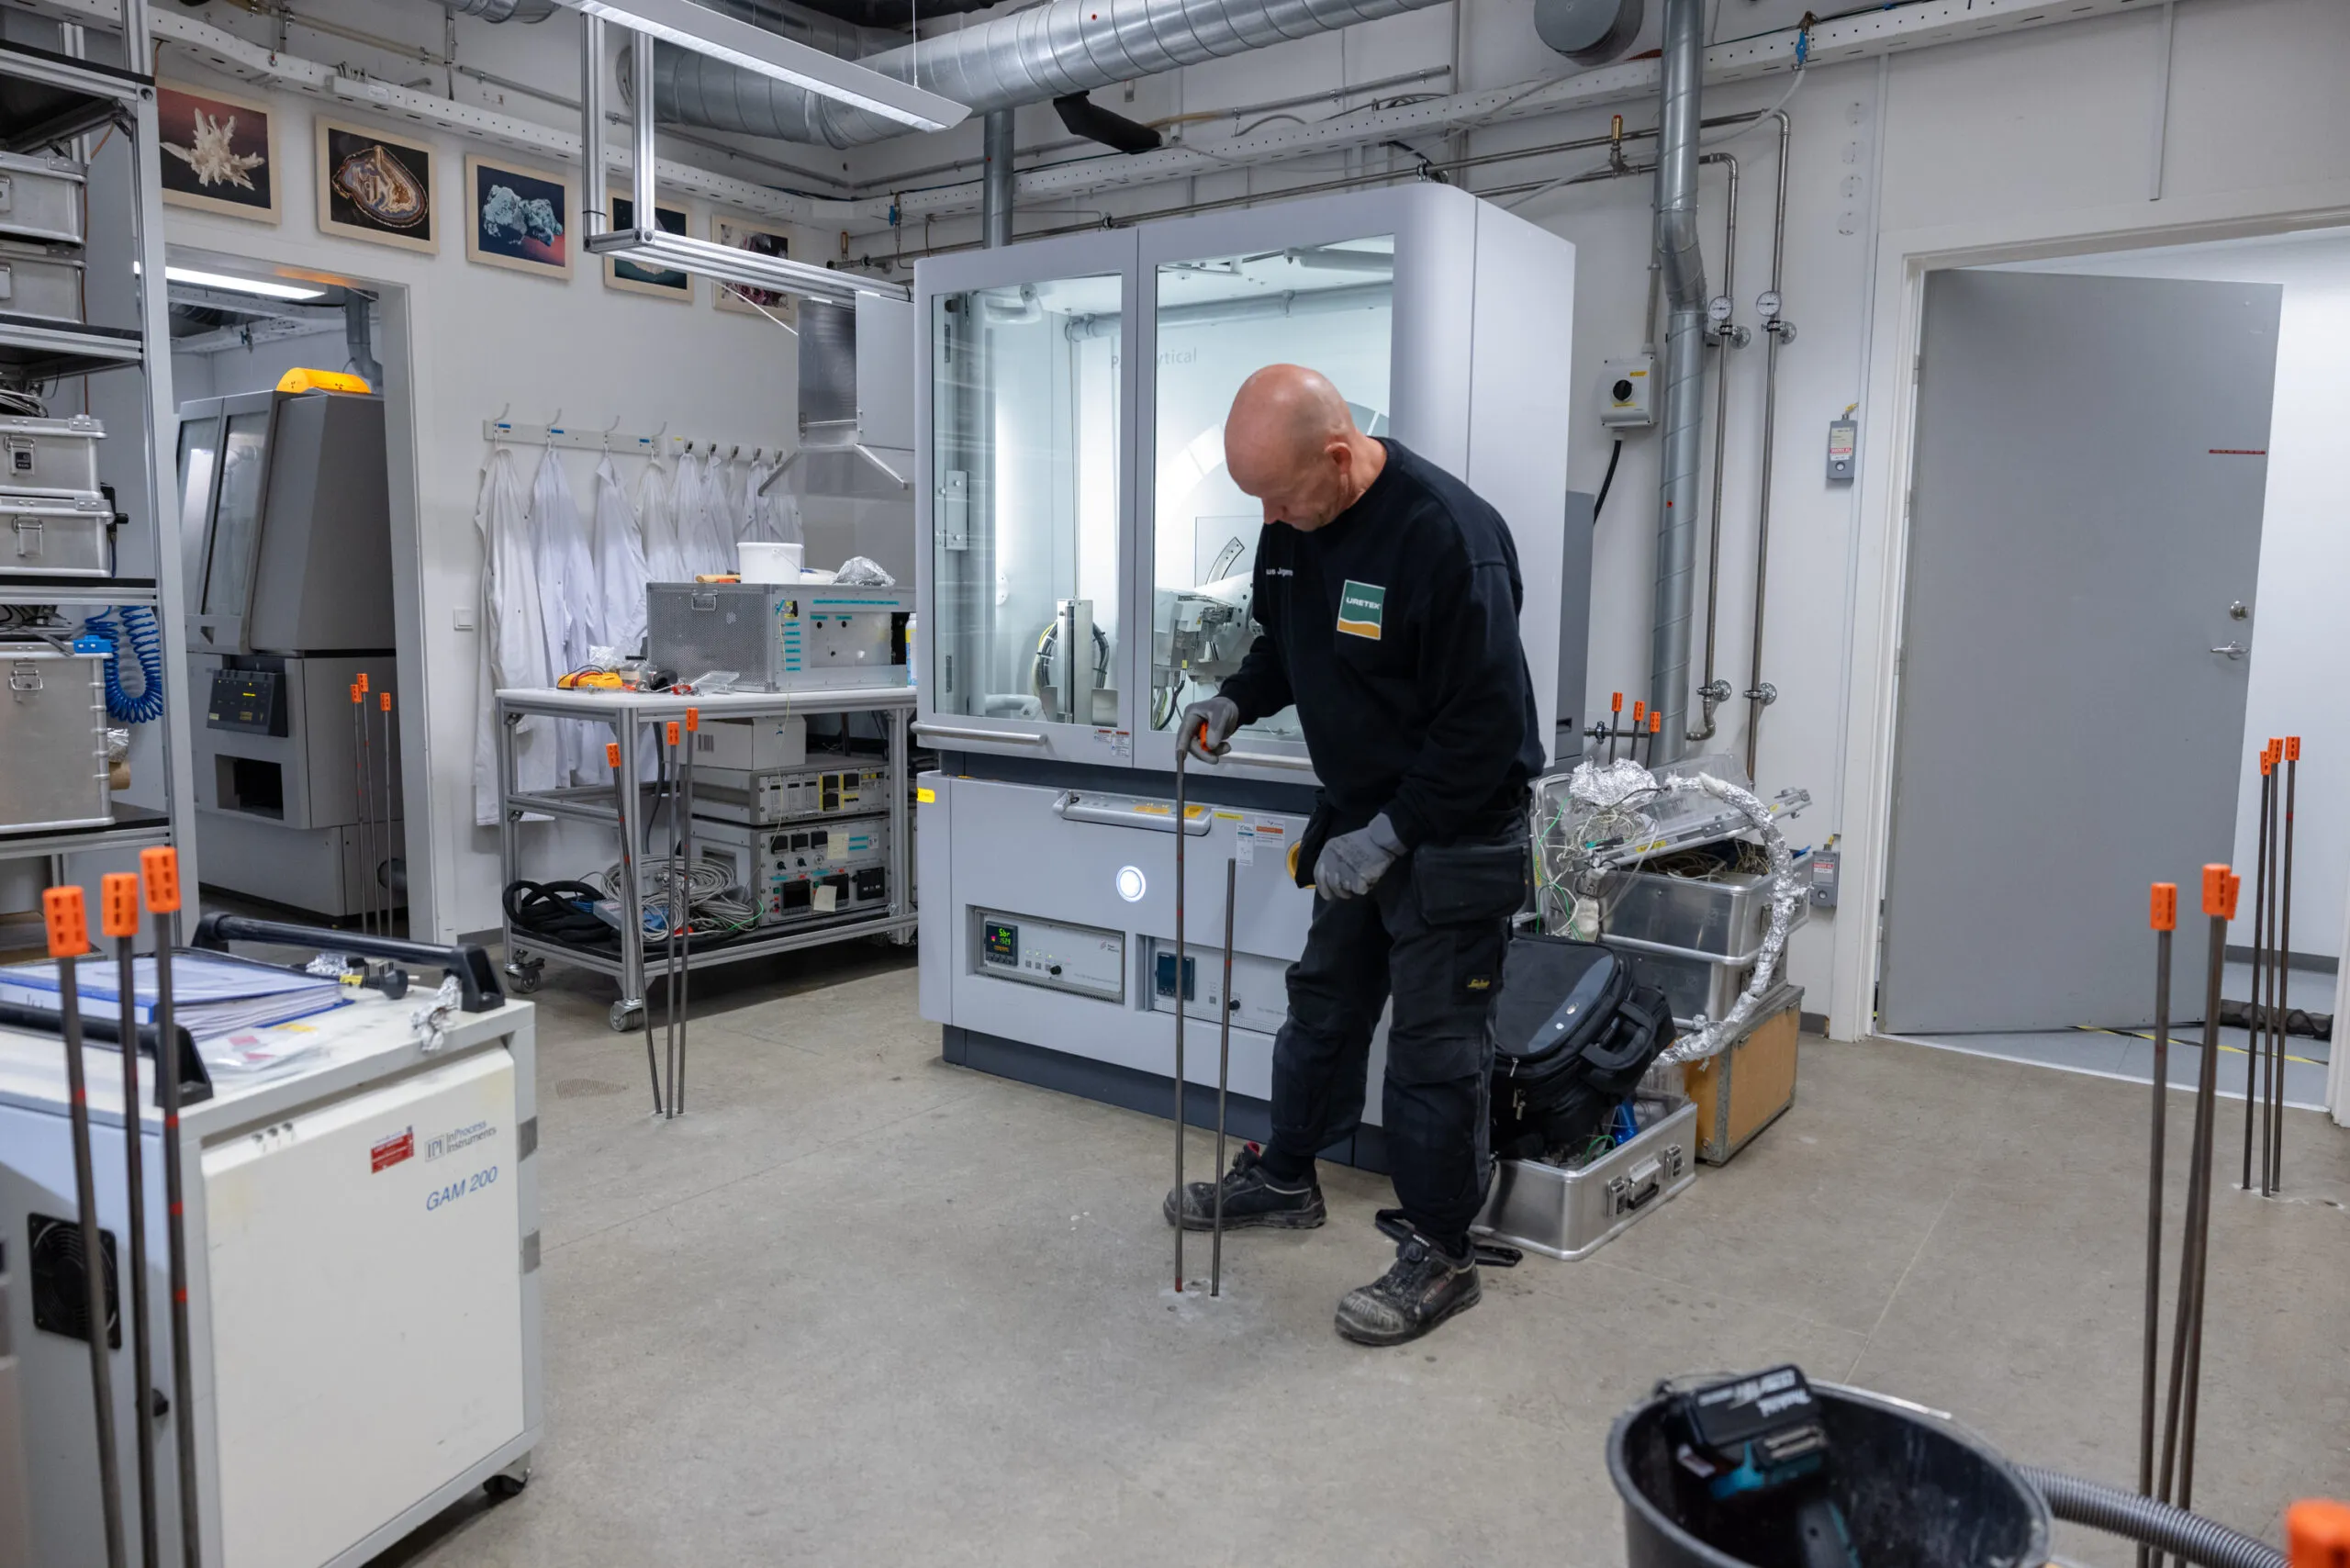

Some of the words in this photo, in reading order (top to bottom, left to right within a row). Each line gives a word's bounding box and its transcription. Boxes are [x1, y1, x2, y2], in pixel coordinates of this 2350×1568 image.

[1346, 597, 1382, 610] URETEX
[447, 1126, 498, 1154] Instruments
[426, 1179, 465, 1211] GAM
[469, 1166, 498, 1193] 200
